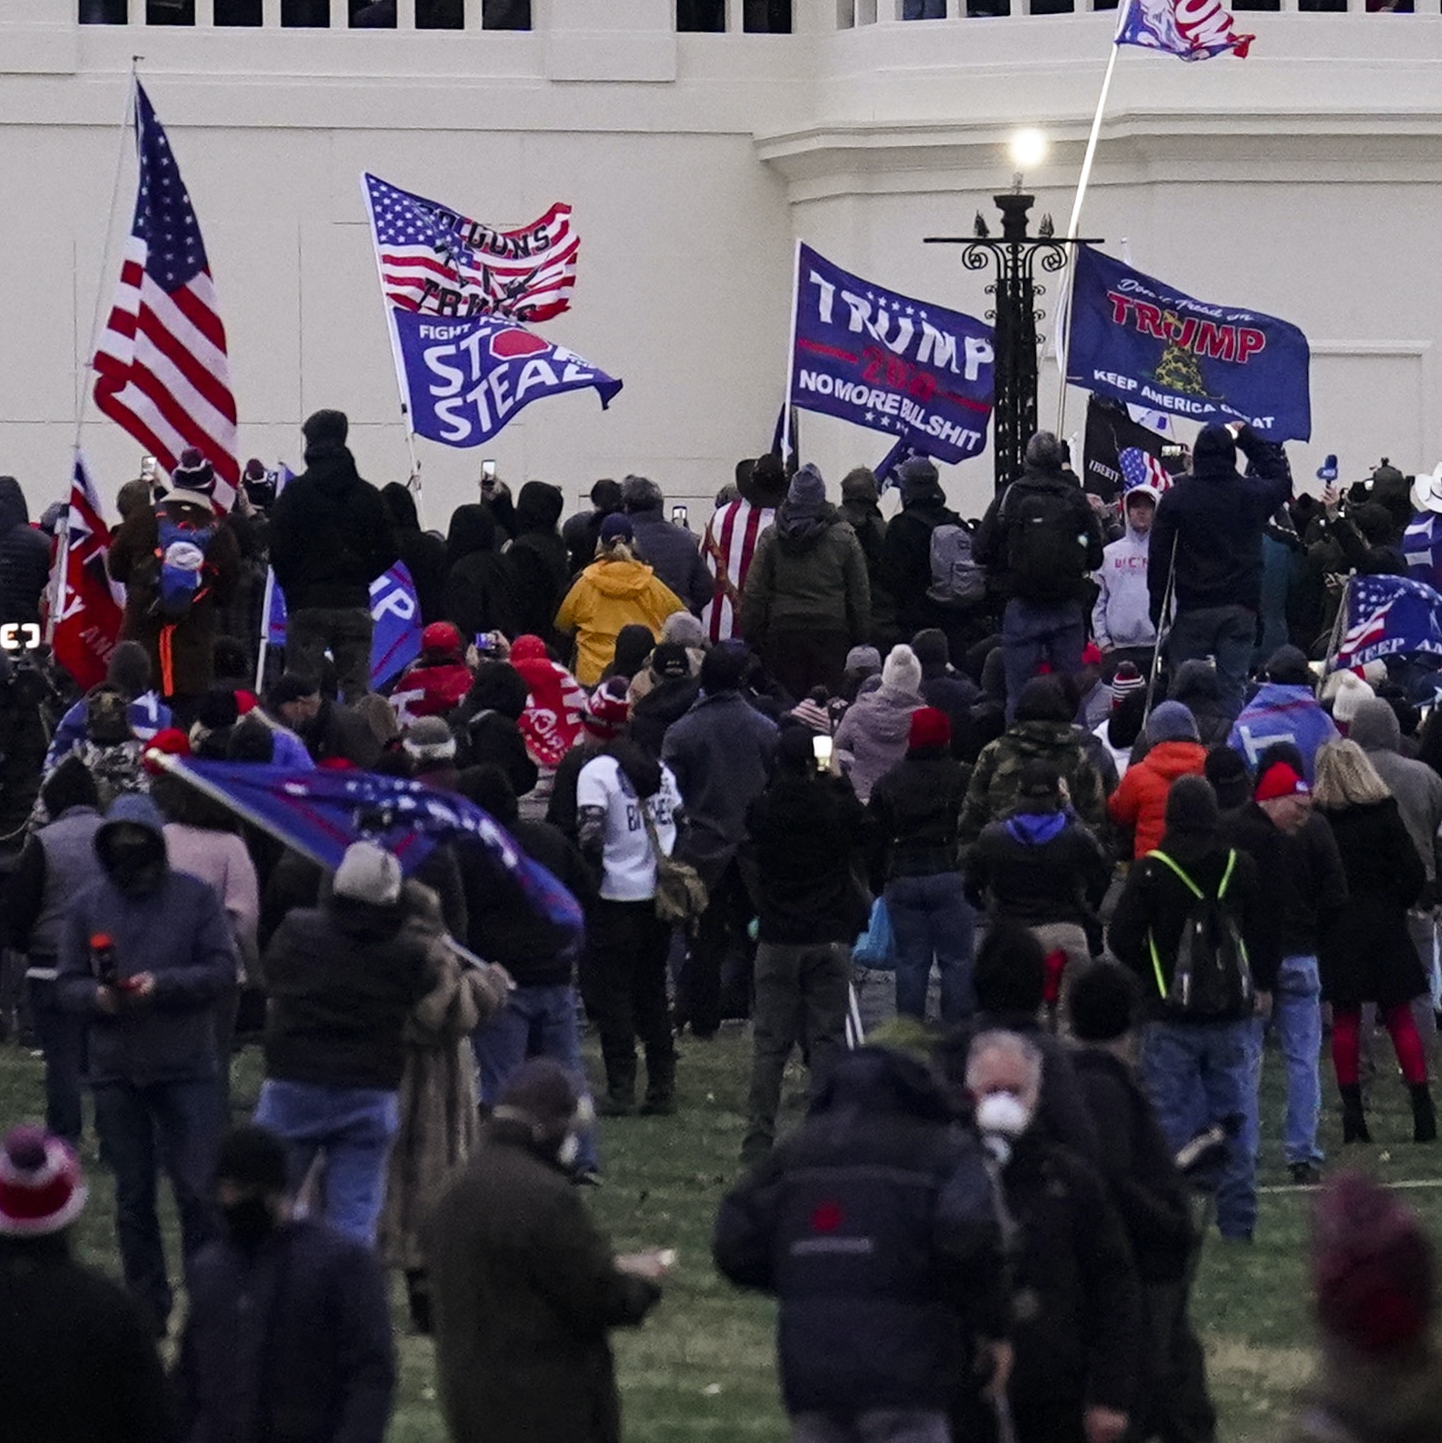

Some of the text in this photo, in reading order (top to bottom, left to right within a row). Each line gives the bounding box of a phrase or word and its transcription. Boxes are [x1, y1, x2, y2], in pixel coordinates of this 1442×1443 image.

[464, 222, 551, 260] GUNS
[418, 322, 471, 341] FIGHT
[809, 269, 995, 382] TRUMP
[1108, 290, 1266, 364] TRUMP
[834, 379, 902, 415] MORE
[1093, 369, 1138, 392] KEEP
[1140, 384, 1217, 415] AMERICA
[1348, 637, 1406, 667] KEEP
